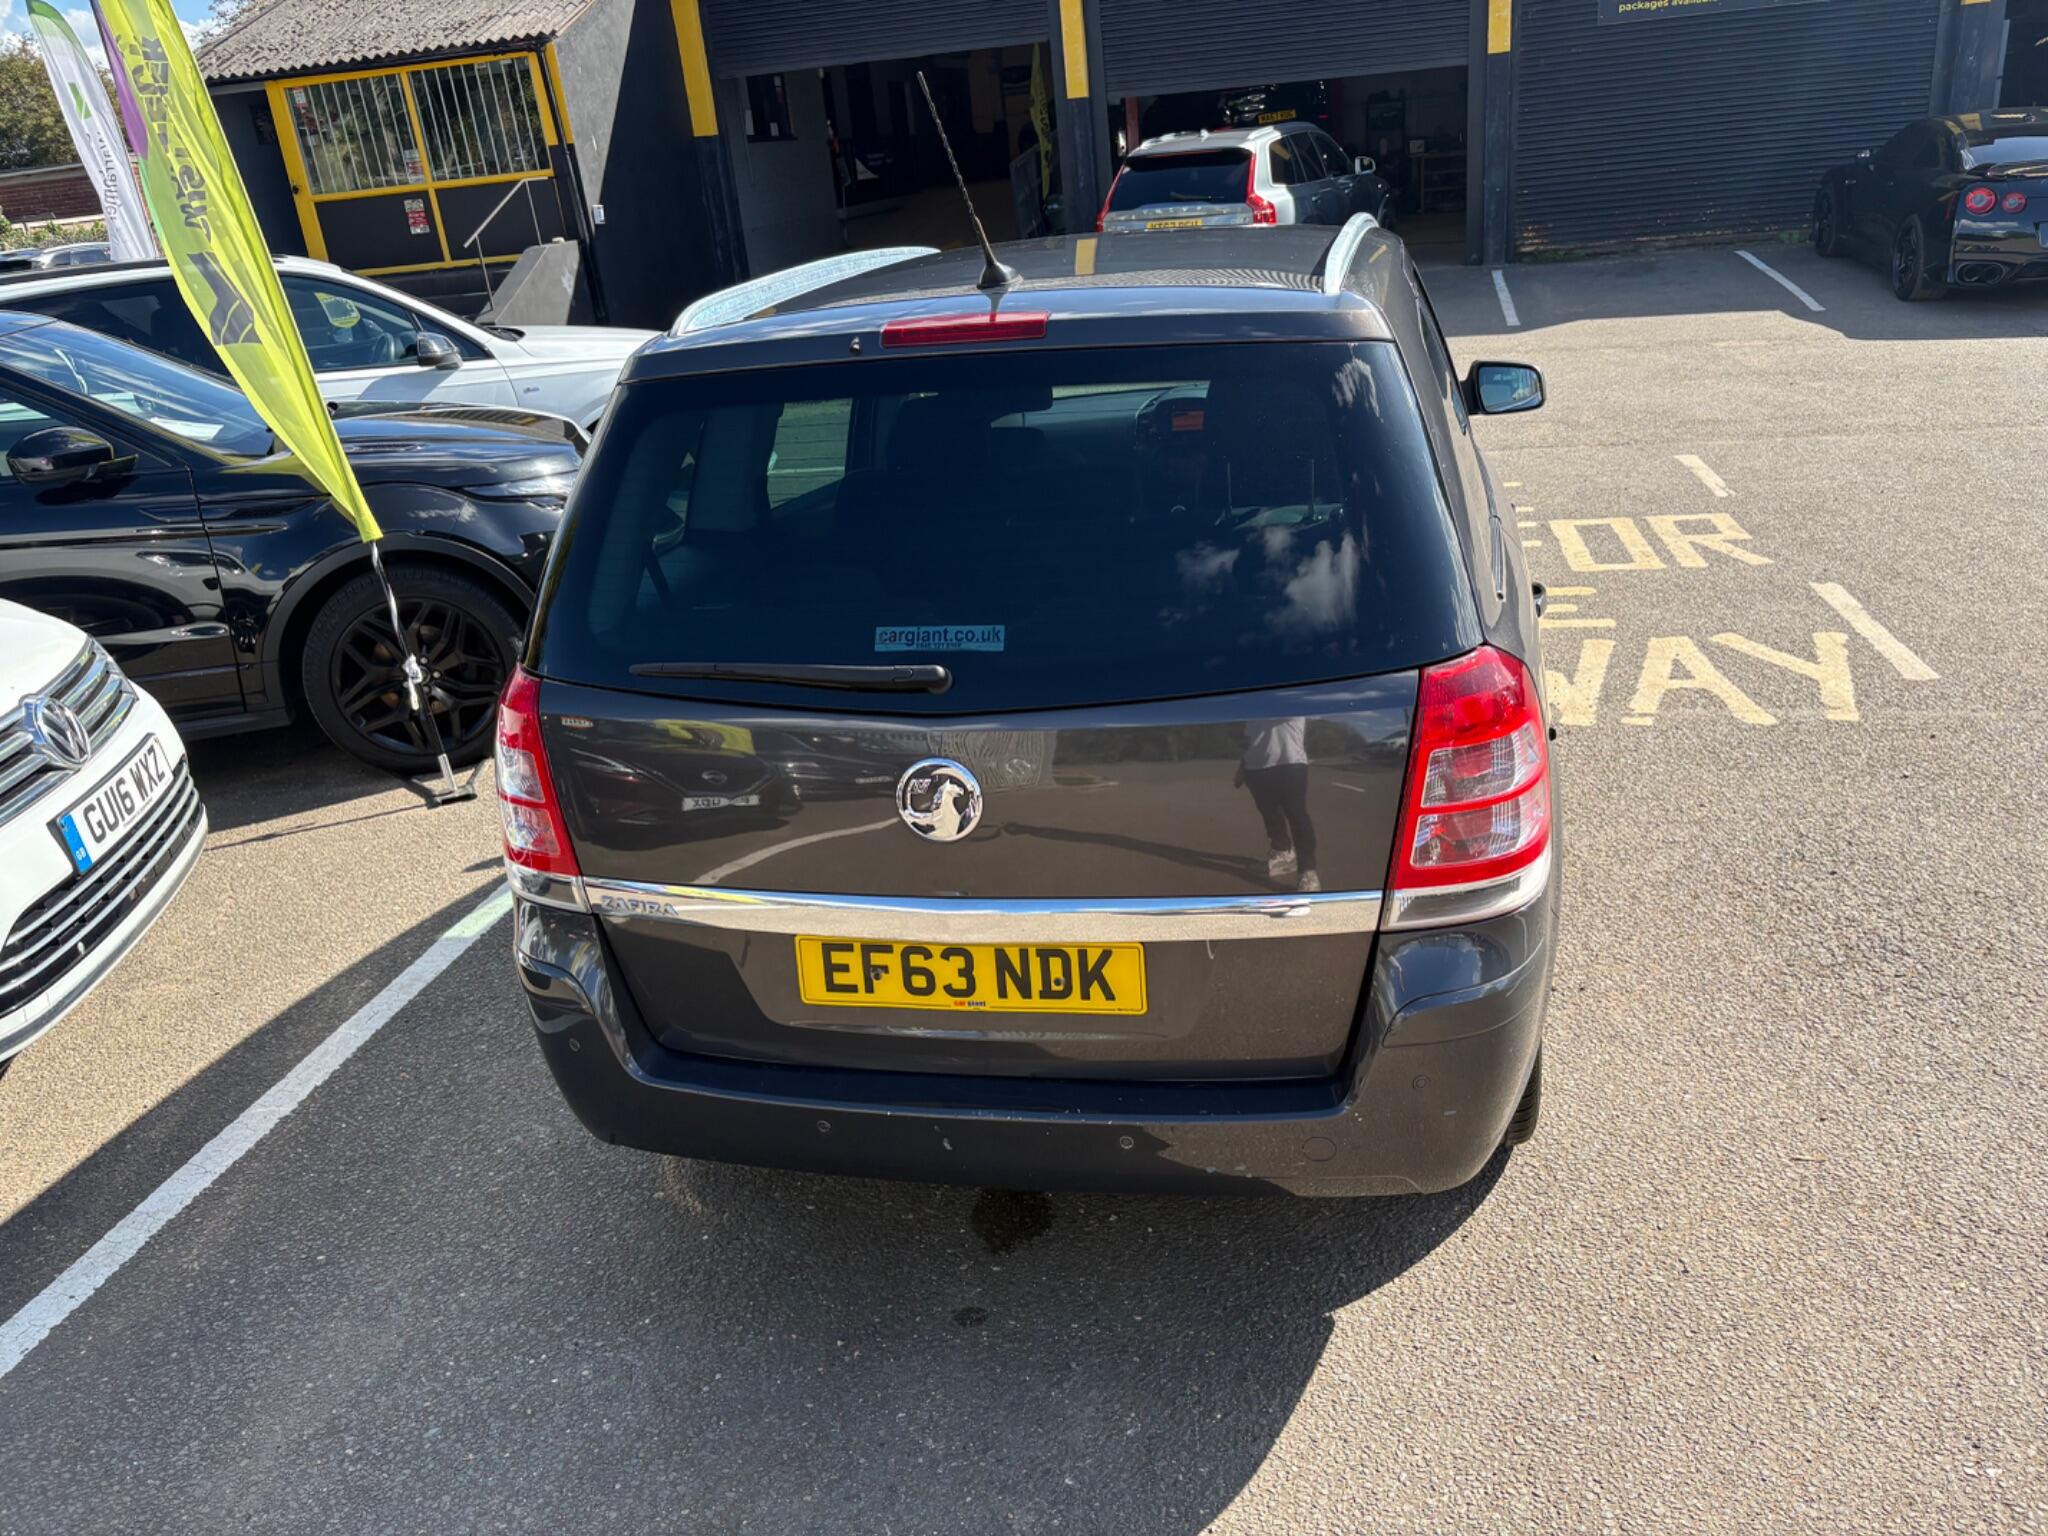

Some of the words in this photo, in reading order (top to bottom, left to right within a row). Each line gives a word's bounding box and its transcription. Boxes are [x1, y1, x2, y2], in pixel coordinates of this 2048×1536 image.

[1619, 0, 1669, 13] packages
[1517, 512, 1774, 572] OR
[880, 626, 1001, 647] cargiant.co.uk
[83, 776, 135, 844] GU16
[129, 744, 166, 801] WXZ
[602, 895, 680, 916] ZAFIRA
[821, 942, 978, 999] EF63
[994, 947, 1116, 1001] NDK
